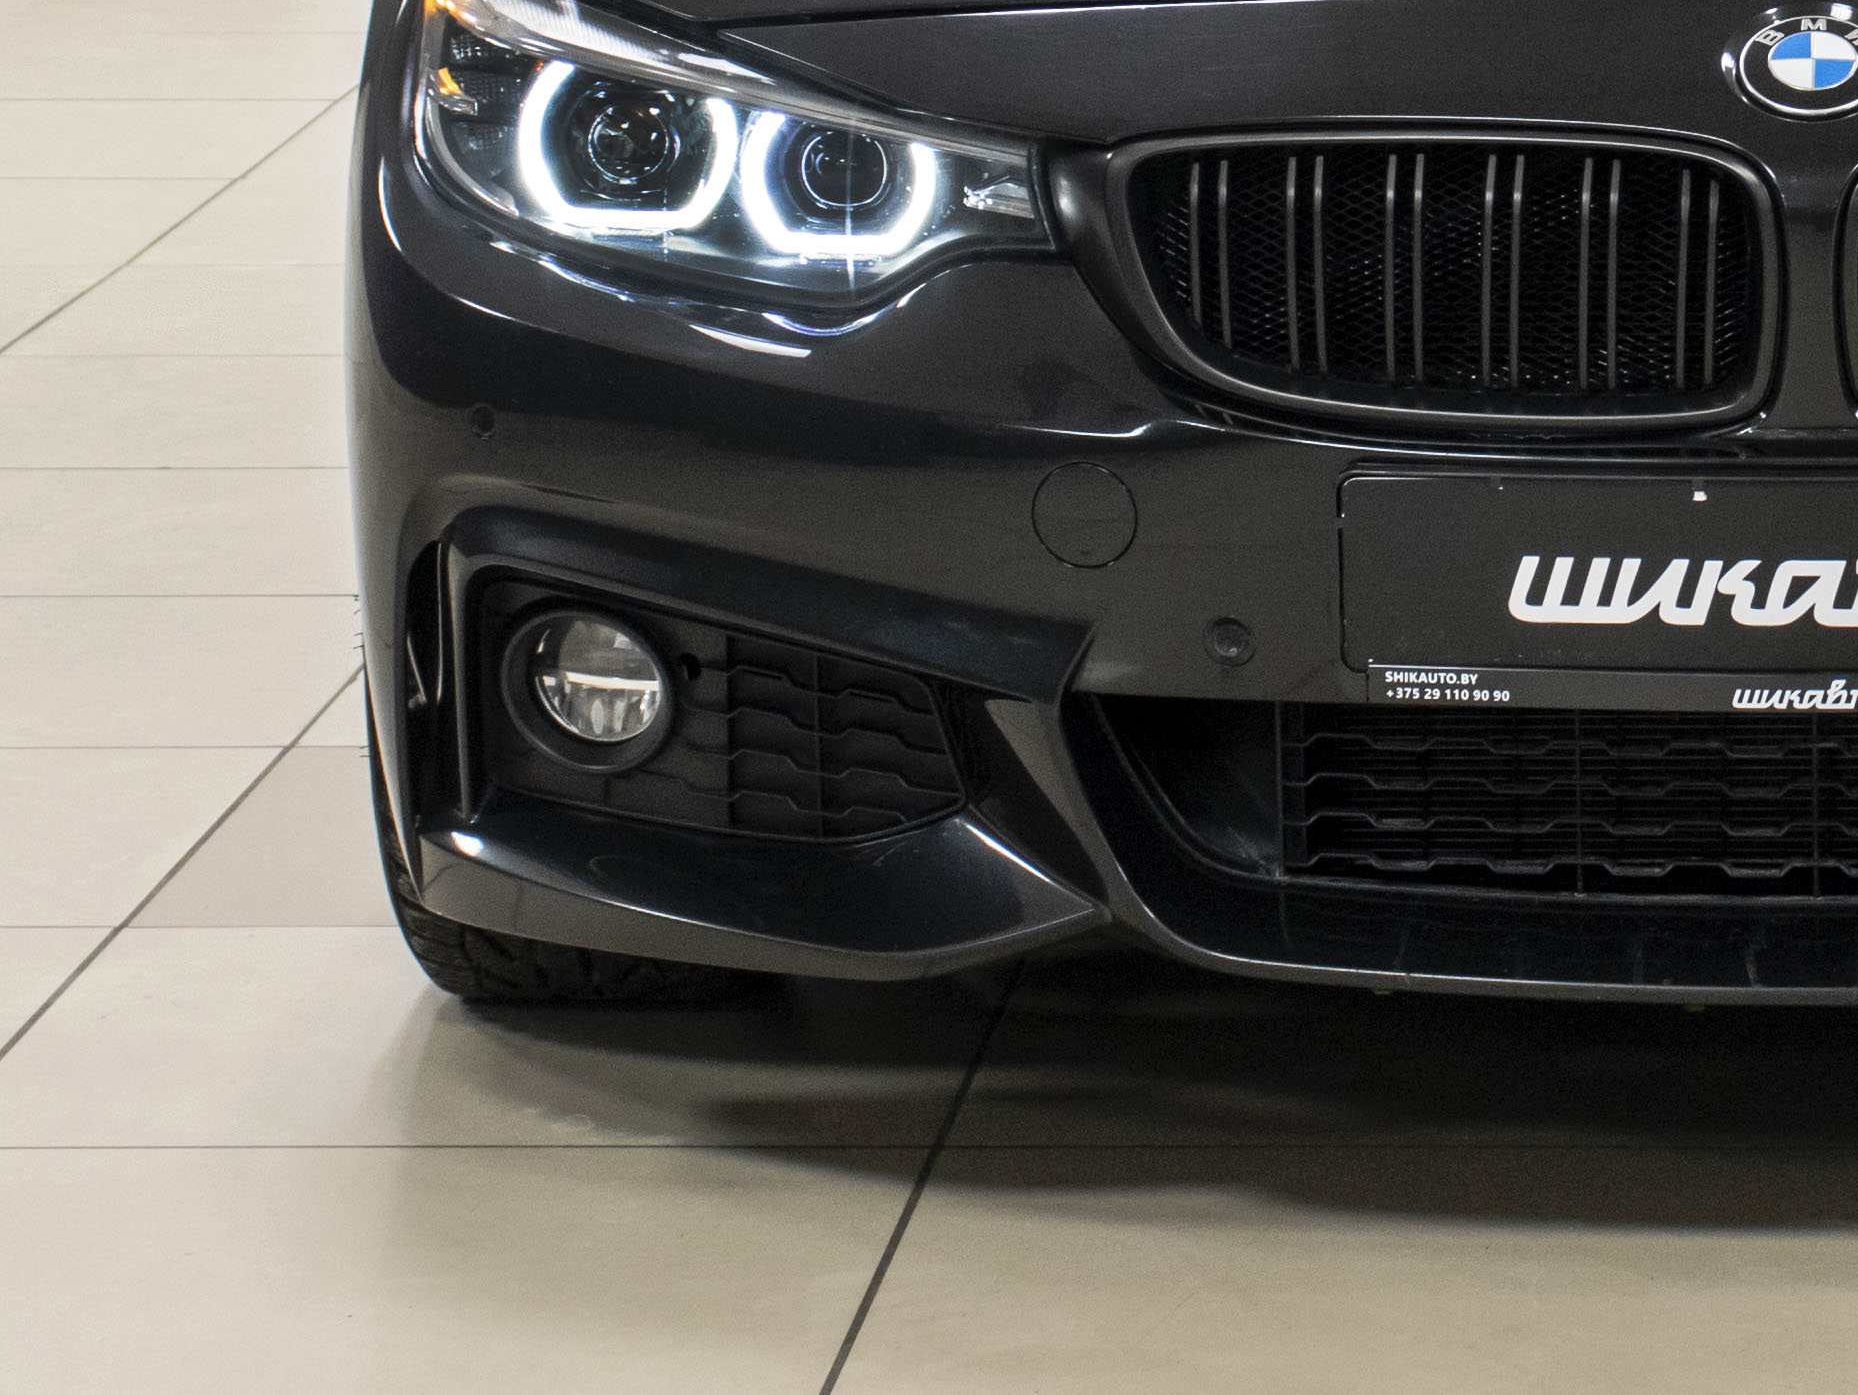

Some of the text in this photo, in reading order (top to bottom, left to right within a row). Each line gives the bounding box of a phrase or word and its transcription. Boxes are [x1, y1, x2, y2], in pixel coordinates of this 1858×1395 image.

[1384, 670, 1479, 686] SHIKAUTO.BY
[1386, 686, 1511, 702] +375 29 110 90 90
